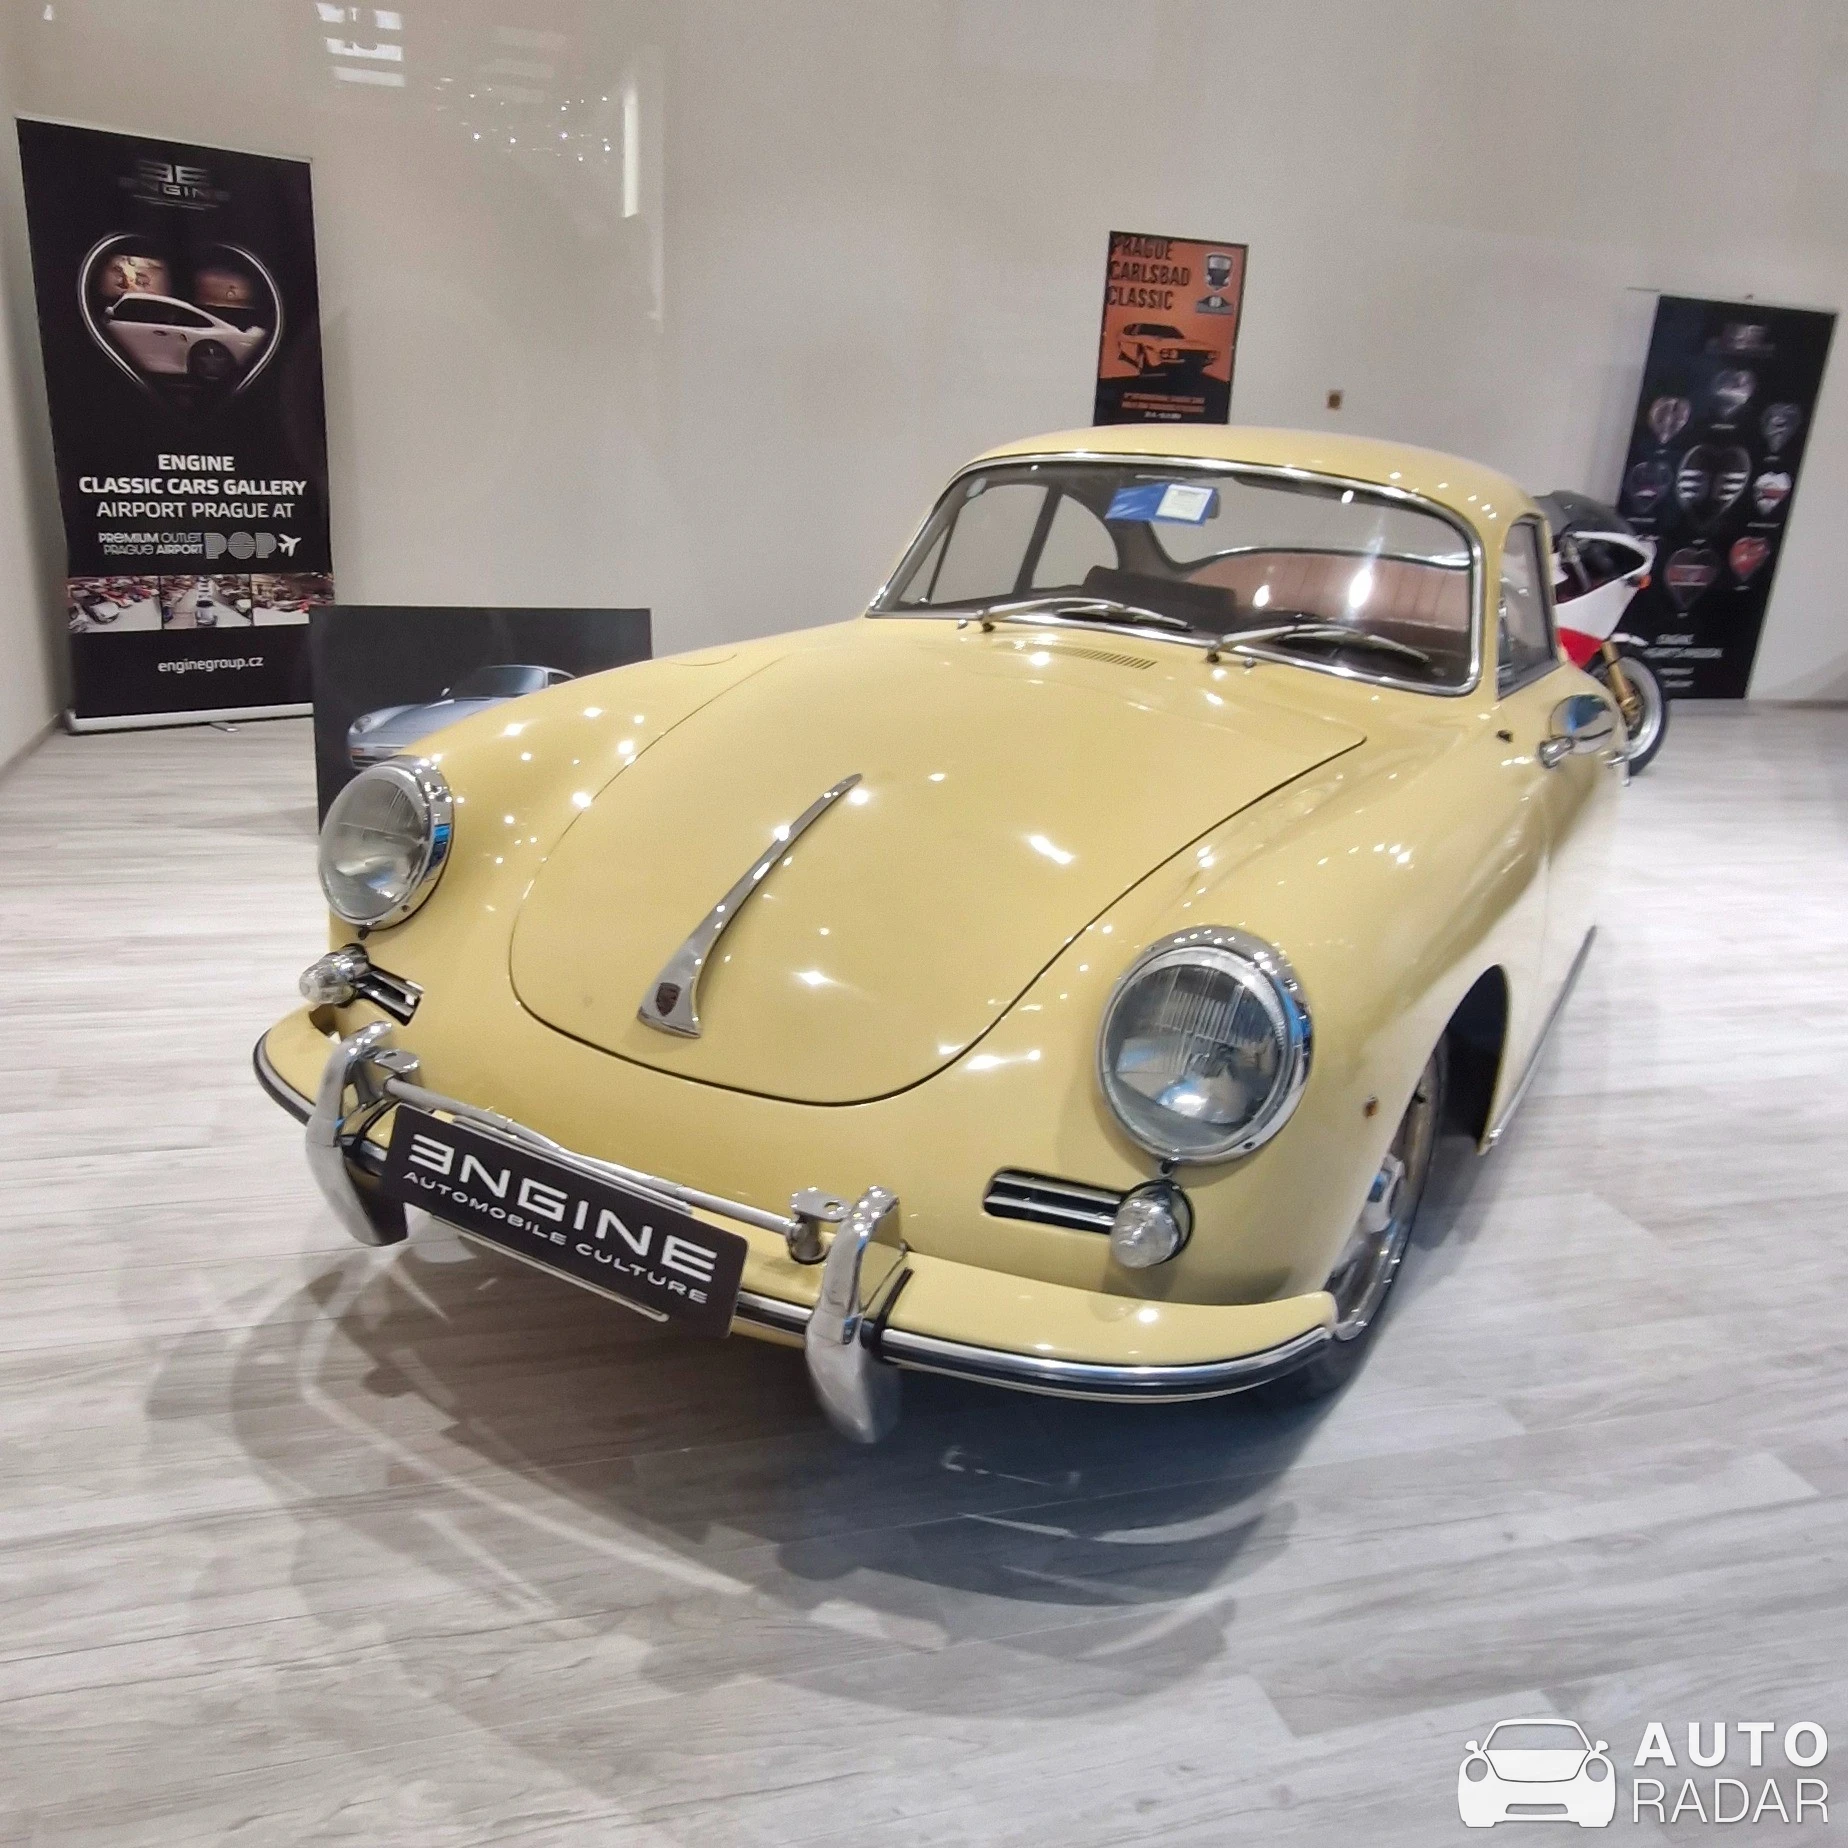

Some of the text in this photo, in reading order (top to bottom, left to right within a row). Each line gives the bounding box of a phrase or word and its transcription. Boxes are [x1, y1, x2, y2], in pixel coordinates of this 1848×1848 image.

[1109, 261, 1190, 286] CARLSBAD
[1108, 286, 1174, 310] CLASSIC
[158, 454, 235, 471] ENGINE
[79, 477, 307, 495] CLASSIC CARS GALLERY
[96, 502, 295, 518] AIRPORT PRAGUE AT
[156, 544, 203, 555] AIRPORT
[204, 532, 277, 560] POP
[158, 657, 264, 674] enginegroup.cz
[403, 1171, 709, 1305] AUTOMOBILE CULTURE
